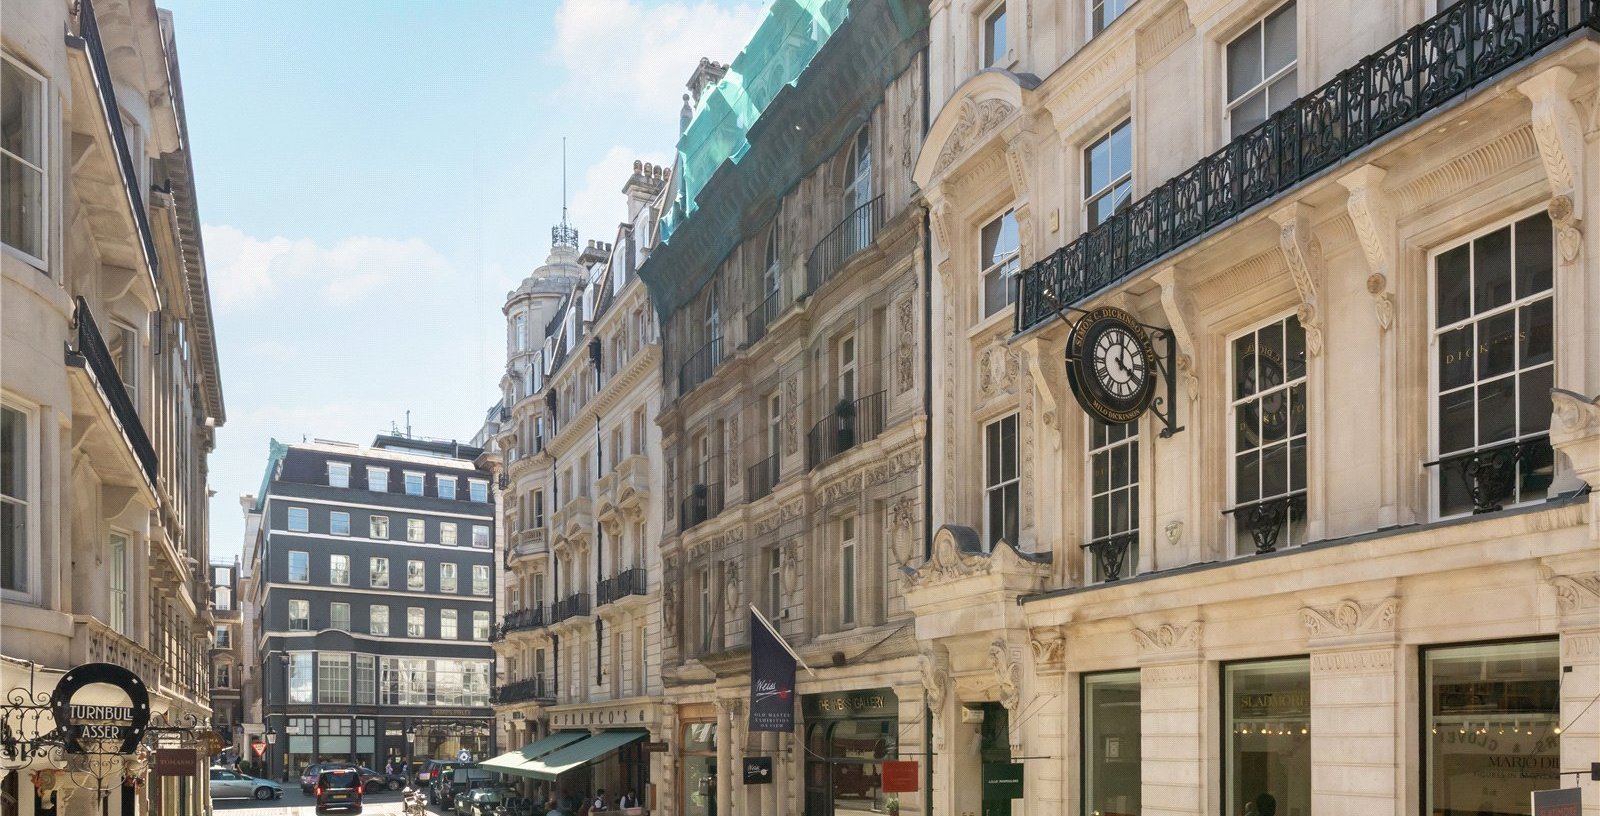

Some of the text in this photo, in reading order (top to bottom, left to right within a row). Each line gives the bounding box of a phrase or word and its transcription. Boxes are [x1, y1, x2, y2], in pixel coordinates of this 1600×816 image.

[1076, 316, 1095, 346] SIMON
[1102, 309, 1144, 339] DICKINSON
[1092, 400, 1140, 420] MILO DICKINSON
[756, 679, 777, 691] Weiss
[854, 696, 885, 709] GALLERY
[70, 706, 133, 721] TURNBULL
[564, 710, 628, 725] FRANCO'S
[82, 726, 119, 739] ASSER
[1488, 756, 1536, 769] MARIO
